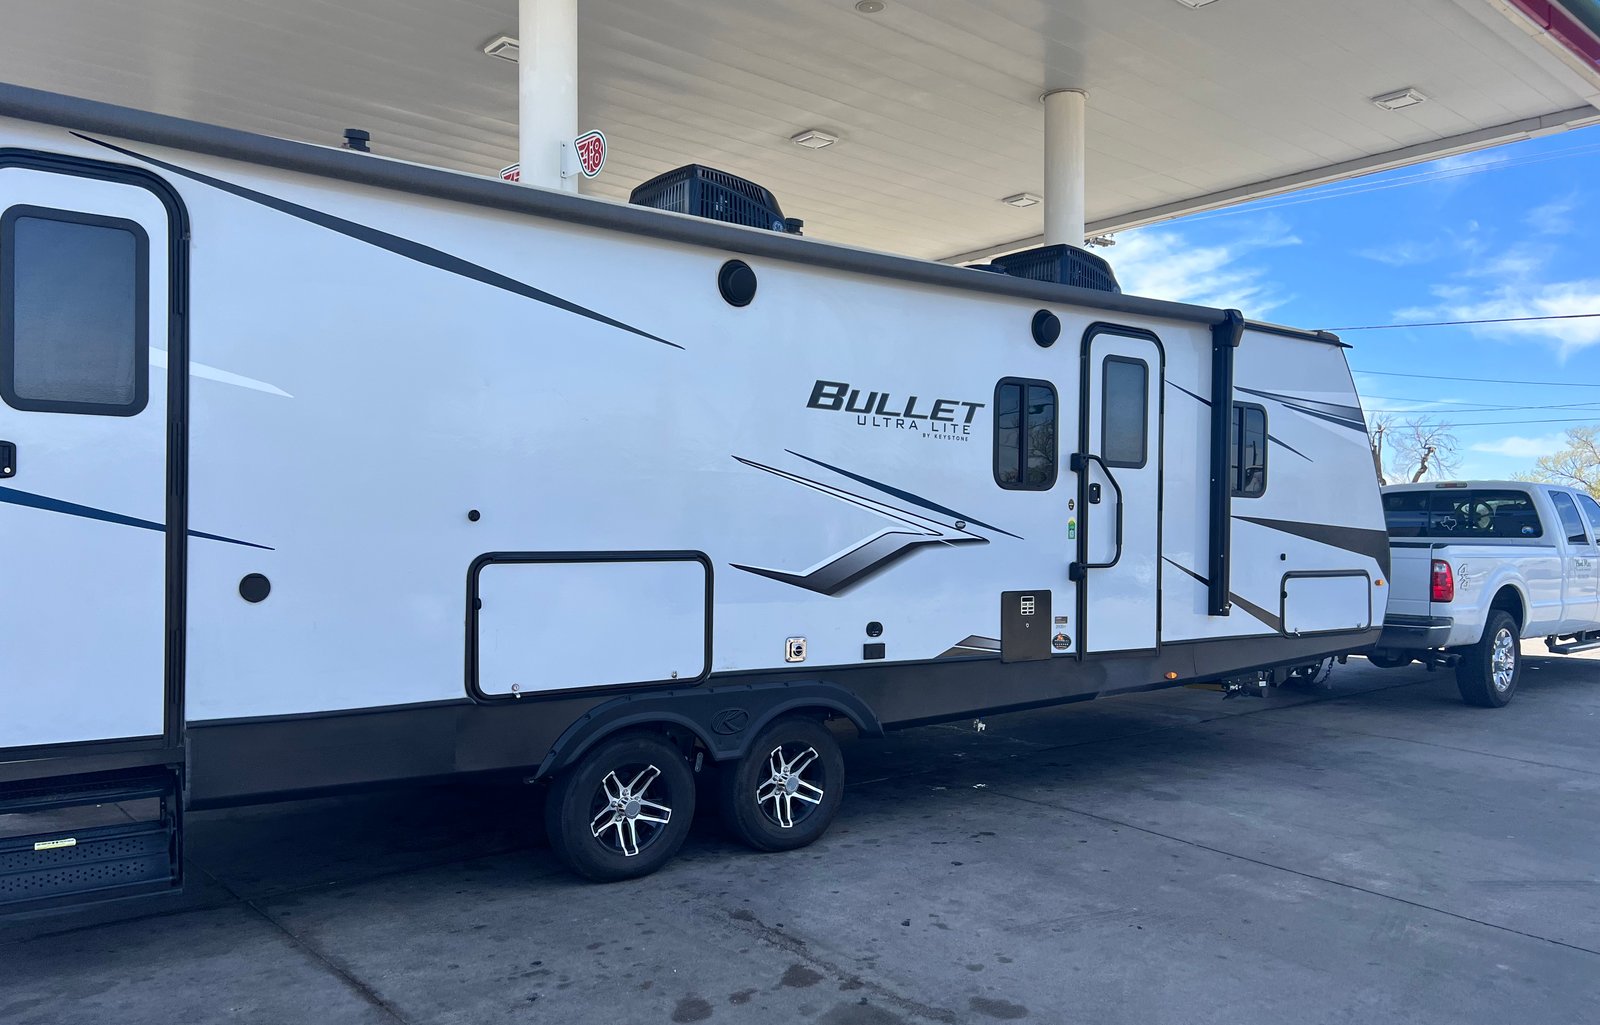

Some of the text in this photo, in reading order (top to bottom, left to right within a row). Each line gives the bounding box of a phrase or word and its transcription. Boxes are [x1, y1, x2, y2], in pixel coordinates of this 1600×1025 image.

[584, 137, 602, 172] 18
[806, 379, 986, 424] BULLET
[857, 415, 971, 435] ULTRA LITE
[934, 433, 969, 442] KEYSTONE
